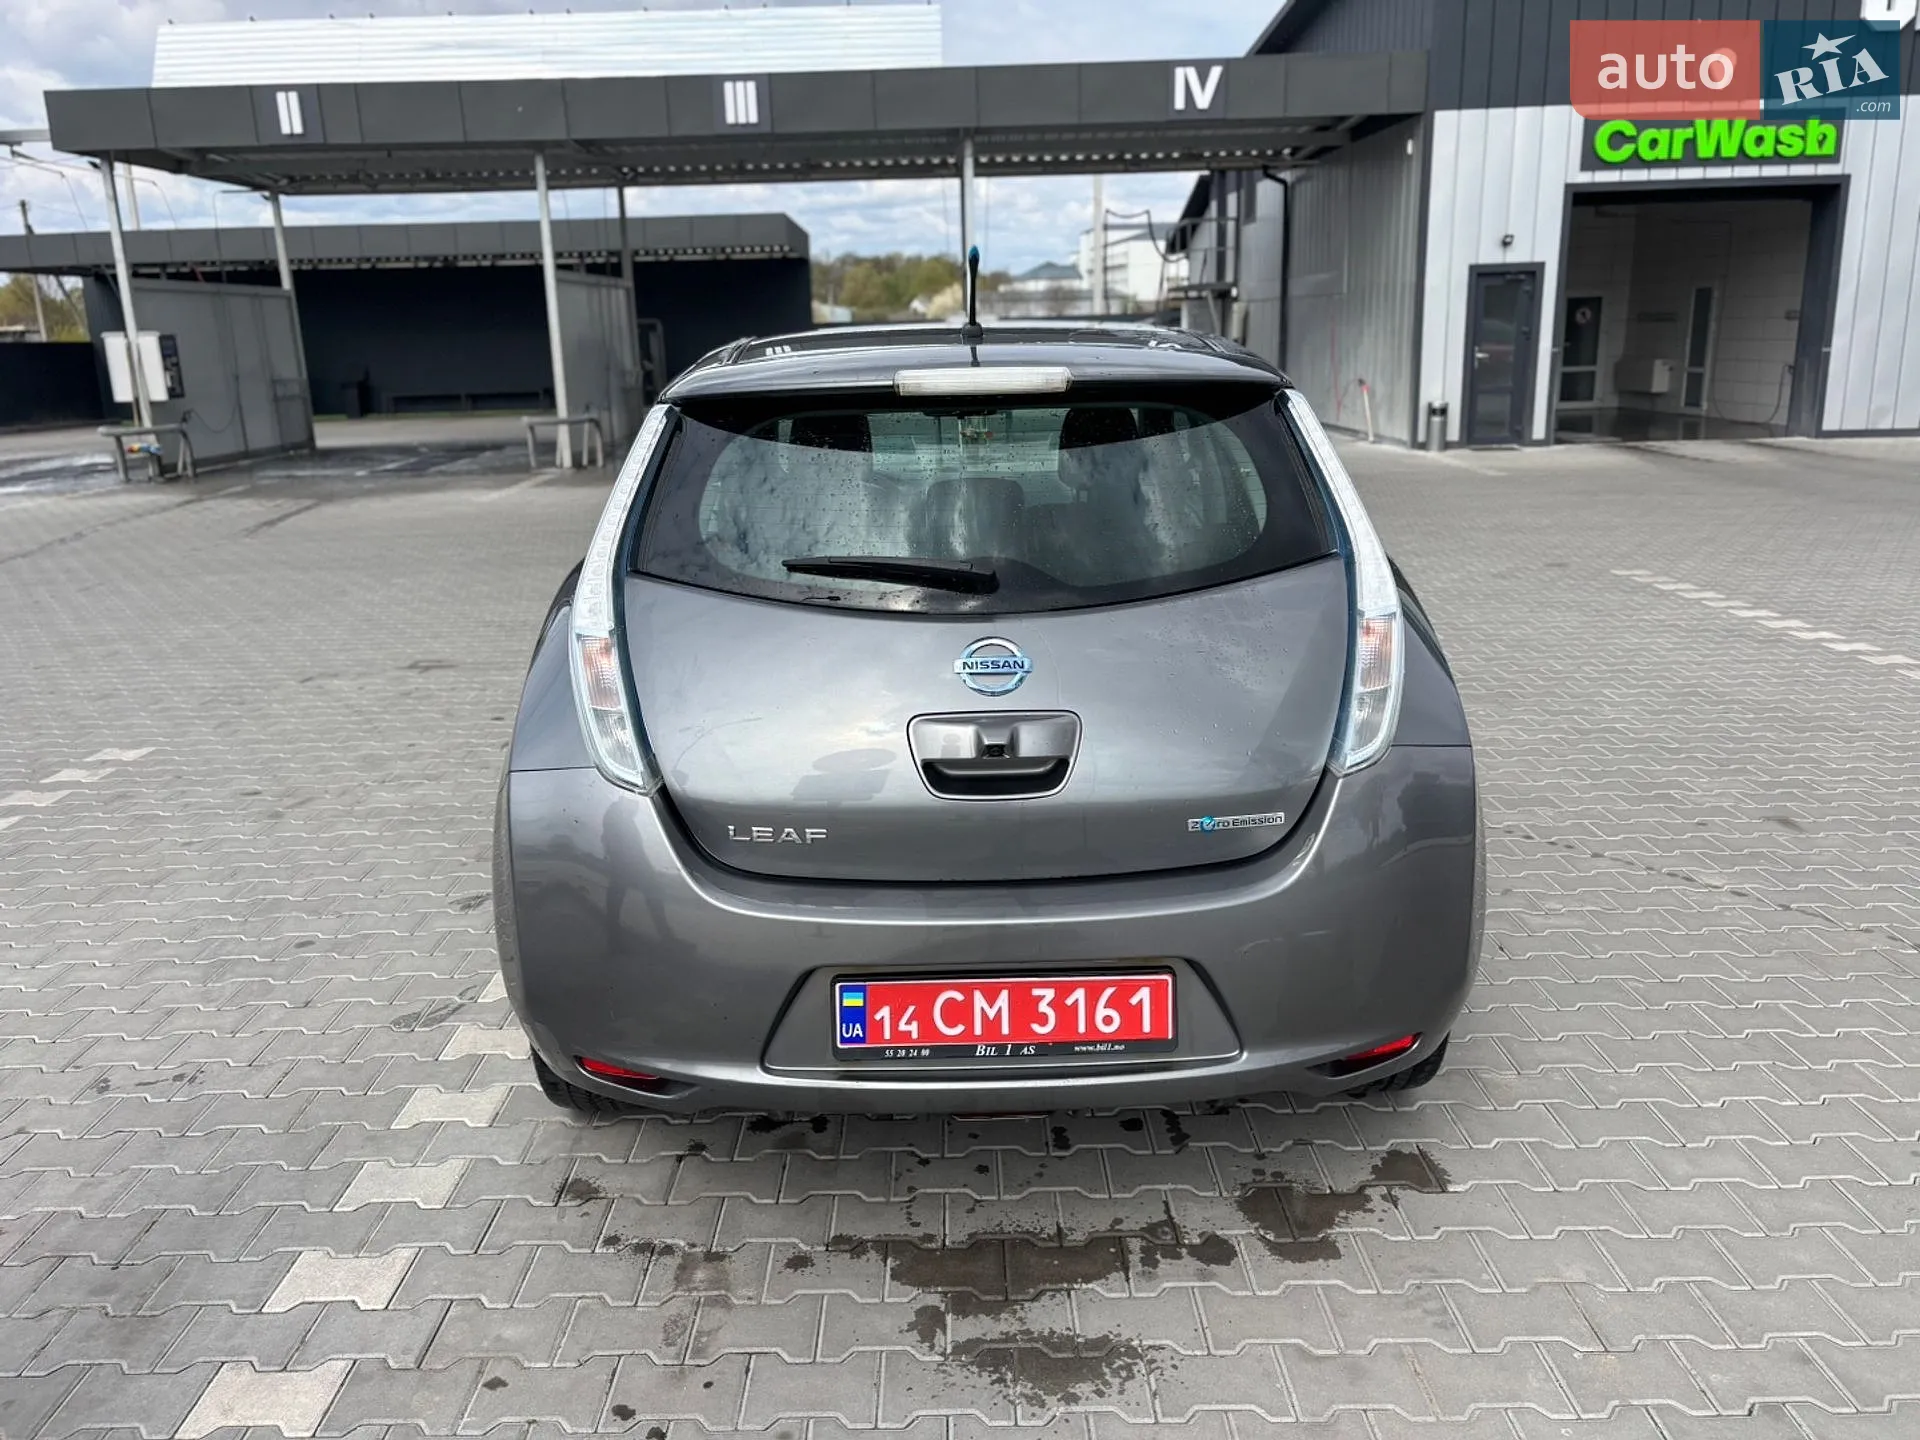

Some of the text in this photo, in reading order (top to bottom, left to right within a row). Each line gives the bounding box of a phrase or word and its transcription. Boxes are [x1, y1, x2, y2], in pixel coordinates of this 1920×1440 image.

[724, 80, 759, 124] III
[1174, 65, 1223, 110] IV
[1594, 115, 1838, 163] CarWash
[962, 660, 1025, 671] NISSAN
[727, 825, 828, 844] LEAF
[1232, 815, 1282, 827] Emission
[873, 986, 1151, 1040] 14 CM 3161
[842, 1023, 864, 1038] UA
